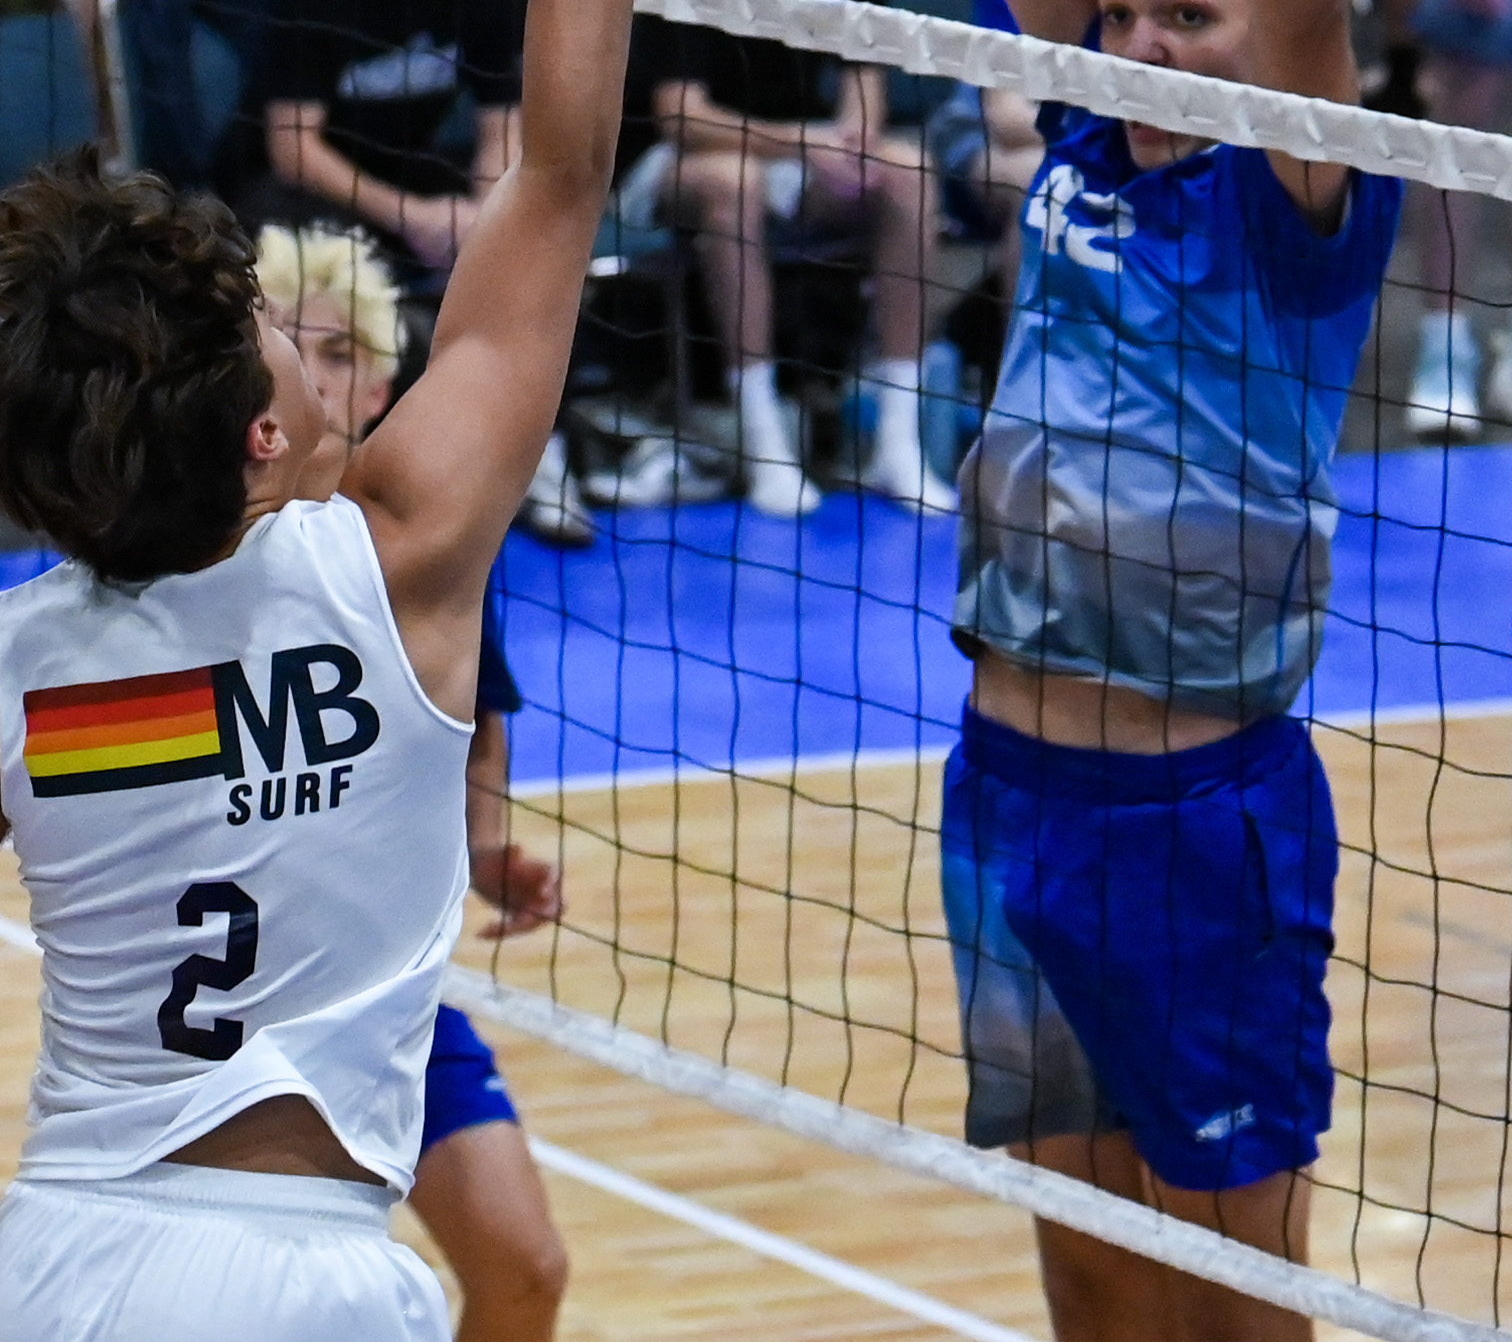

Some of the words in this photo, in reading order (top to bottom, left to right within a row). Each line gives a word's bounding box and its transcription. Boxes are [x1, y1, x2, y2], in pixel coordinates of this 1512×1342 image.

[211, 643, 381, 781] MB
[226, 764, 354, 827] SURF
[157, 881, 259, 1061] 2
